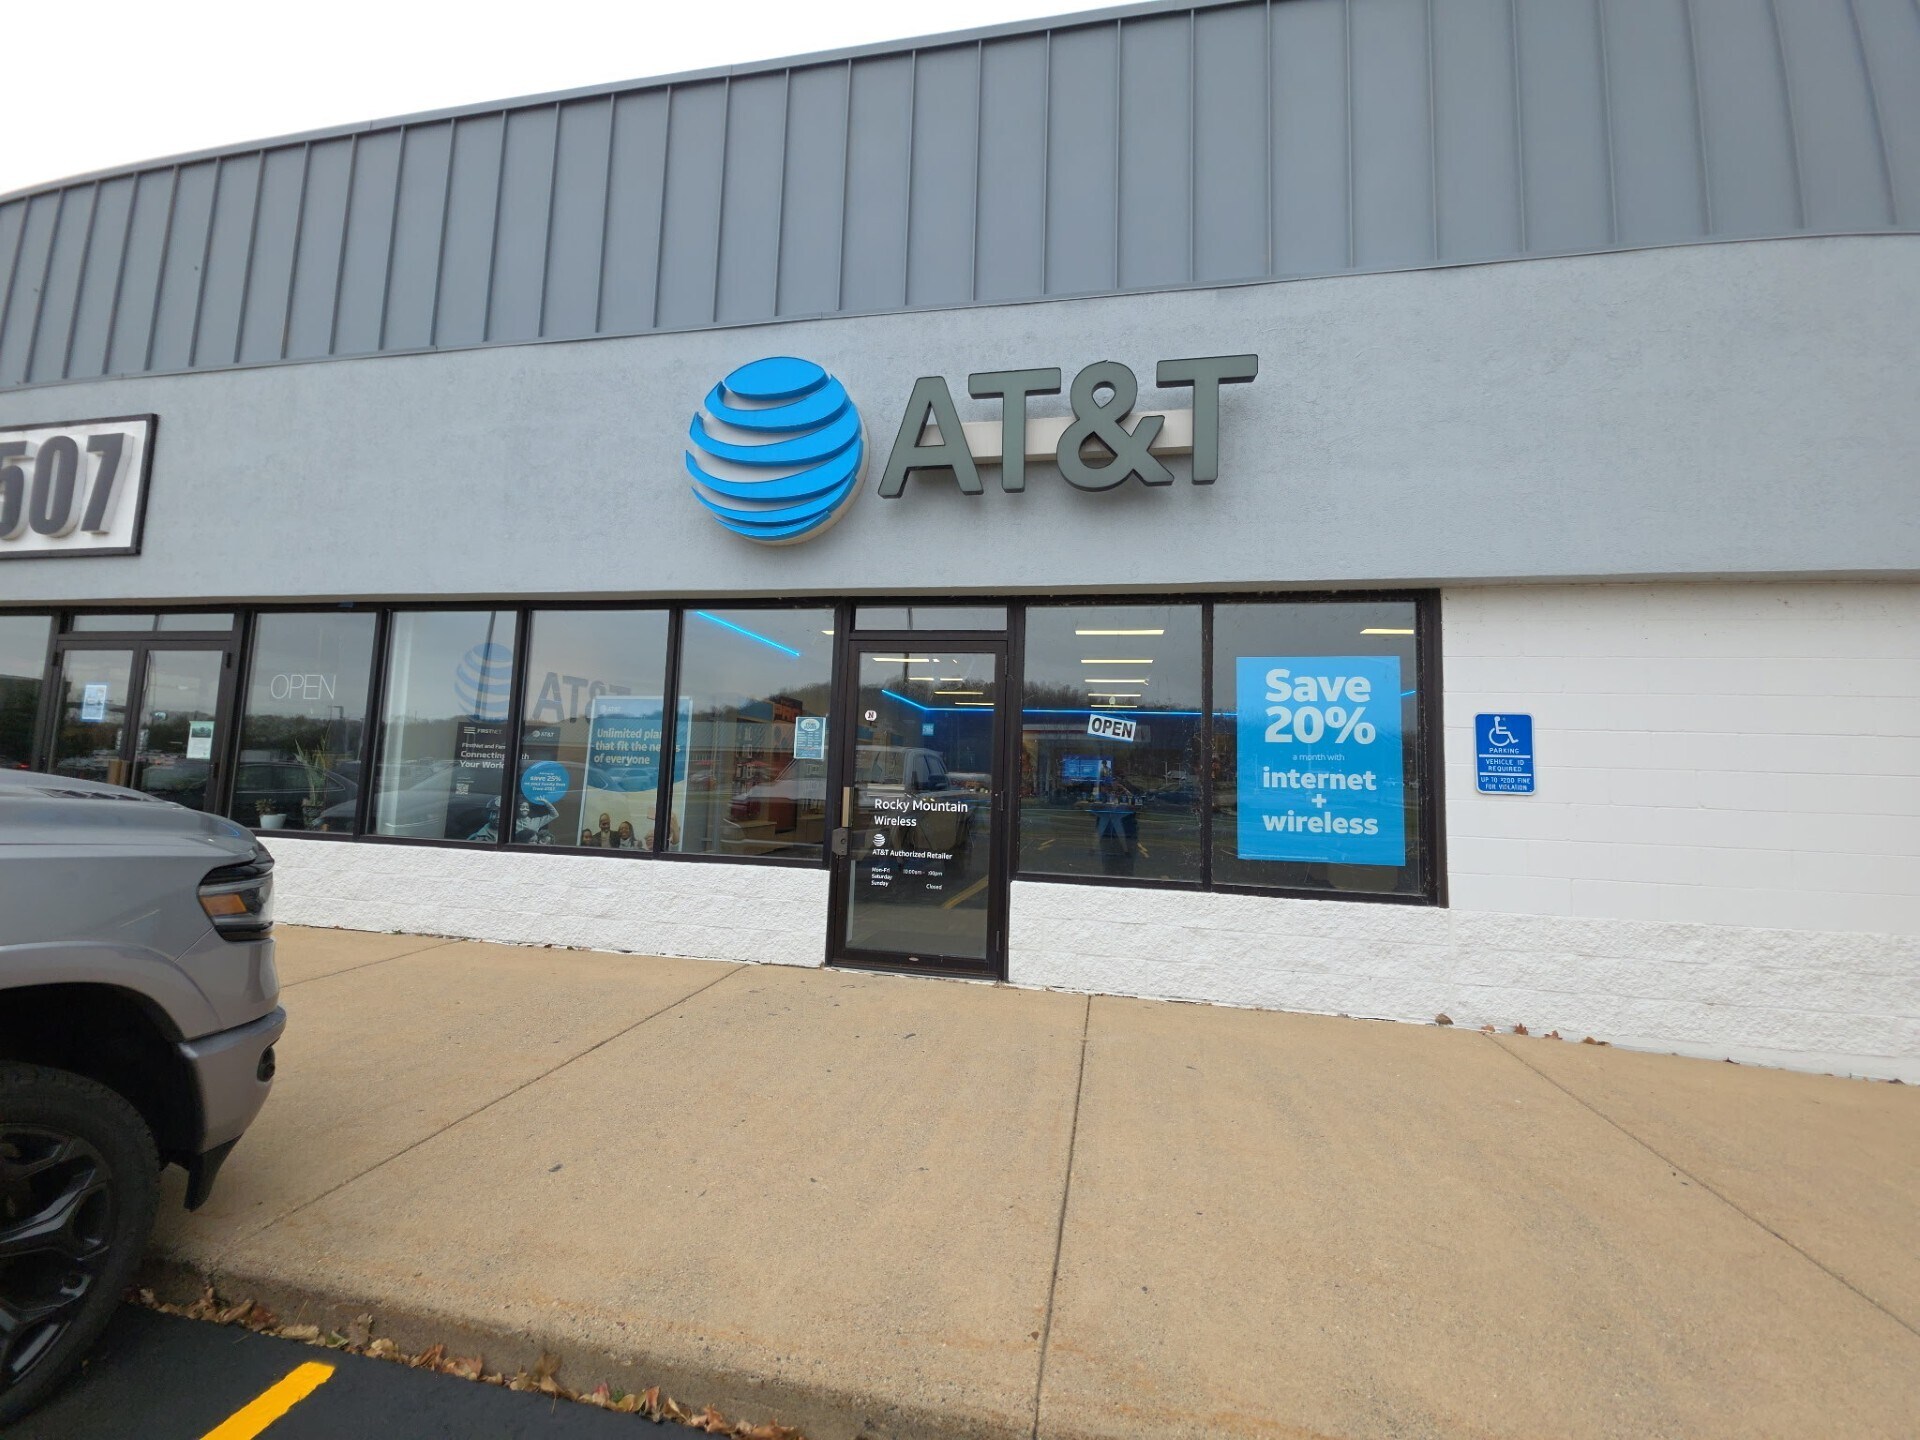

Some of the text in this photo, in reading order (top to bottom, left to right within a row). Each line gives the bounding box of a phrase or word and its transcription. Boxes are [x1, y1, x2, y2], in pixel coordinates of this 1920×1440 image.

[878, 354, 1258, 498] AT&T
[0, 432, 133, 540] 507
[270, 674, 336, 700] OPEN
[1265, 668, 1371, 703] Save
[1091, 717, 1133, 738] OPEN
[1264, 705, 1376, 745] 20%
[597, 728, 662, 741] Unlimited pla
[595, 740, 614, 751] that
[617, 740, 629, 751] fit
[631, 740, 647, 752] the
[460, 750, 505, 760] Connecting
[594, 753, 650, 767] of everyone
[1299, 753, 1326, 761] month
[1326, 753, 1345, 761] with
[459, 760, 480, 768] Your
[1262, 766, 1377, 791] internet
[874, 798, 968, 813] Rocky Mountain
[1311, 793, 1327, 808] +
[873, 815, 917, 827] Wireless
[1262, 809, 1379, 836] wireless
[872, 848, 953, 860] AT&T Authorized Retailer
[871, 880, 889, 888] Sunday
